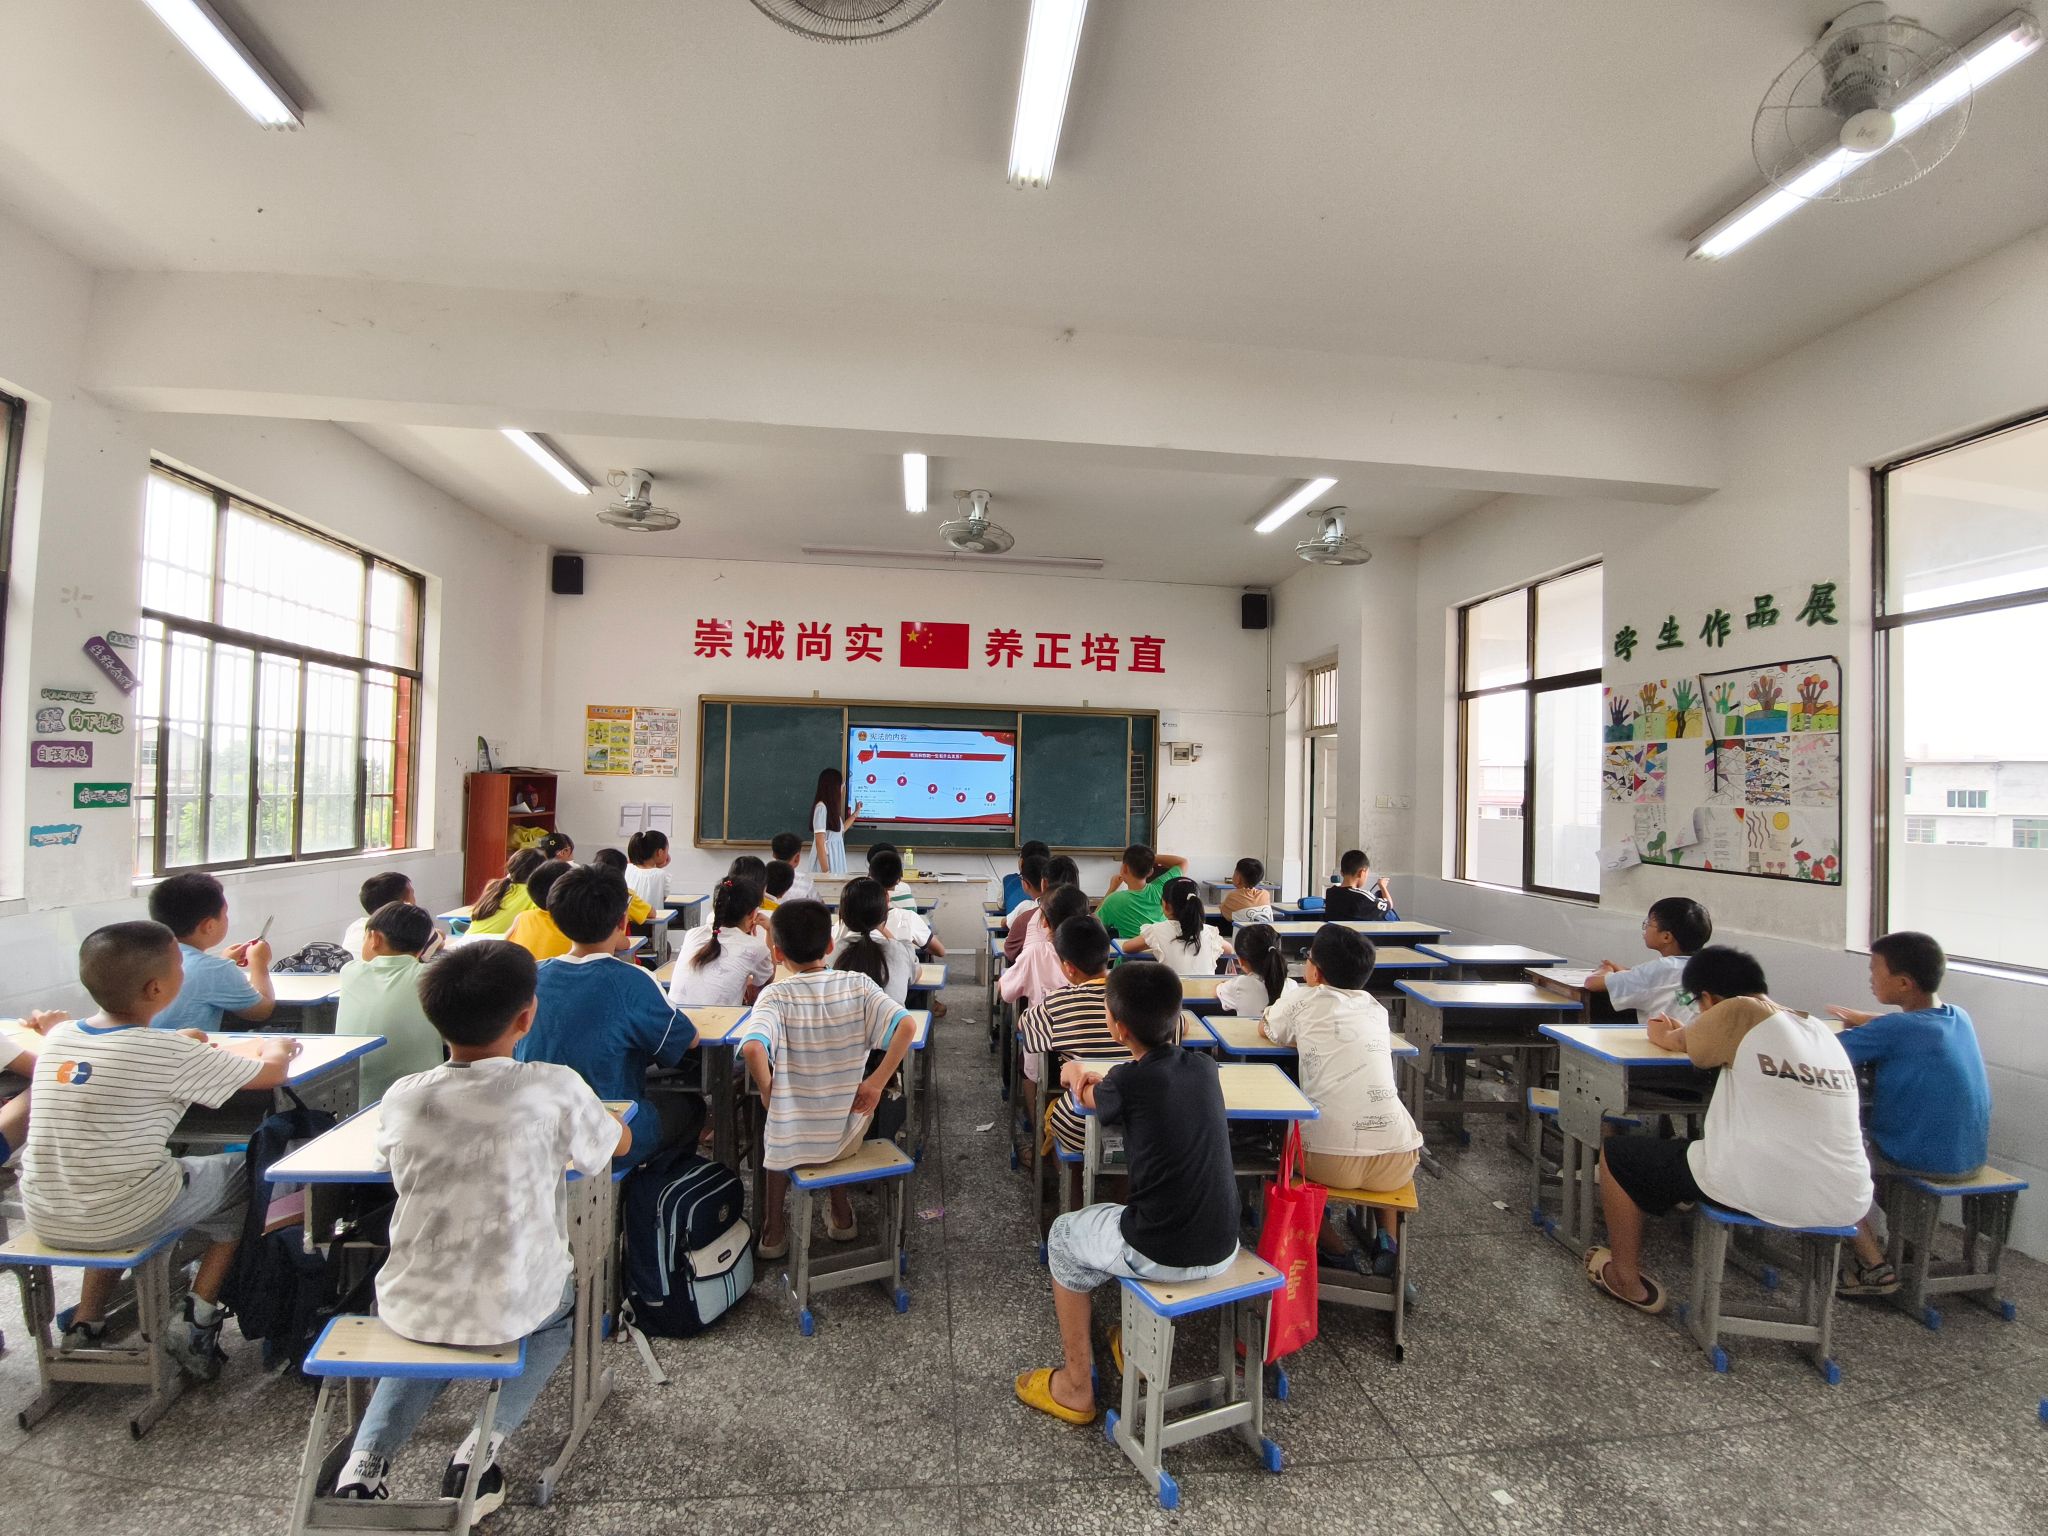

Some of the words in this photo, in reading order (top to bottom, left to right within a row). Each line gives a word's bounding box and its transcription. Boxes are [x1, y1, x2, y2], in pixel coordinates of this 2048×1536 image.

[1614, 582, 1839, 662] 学生作品展
[693, 617, 884, 663] 崇诚尚实
[985, 628, 1167, 674] 养正培直
[70, 710, 123, 732] 向下扎根
[38, 746, 88, 762] 自强不息
